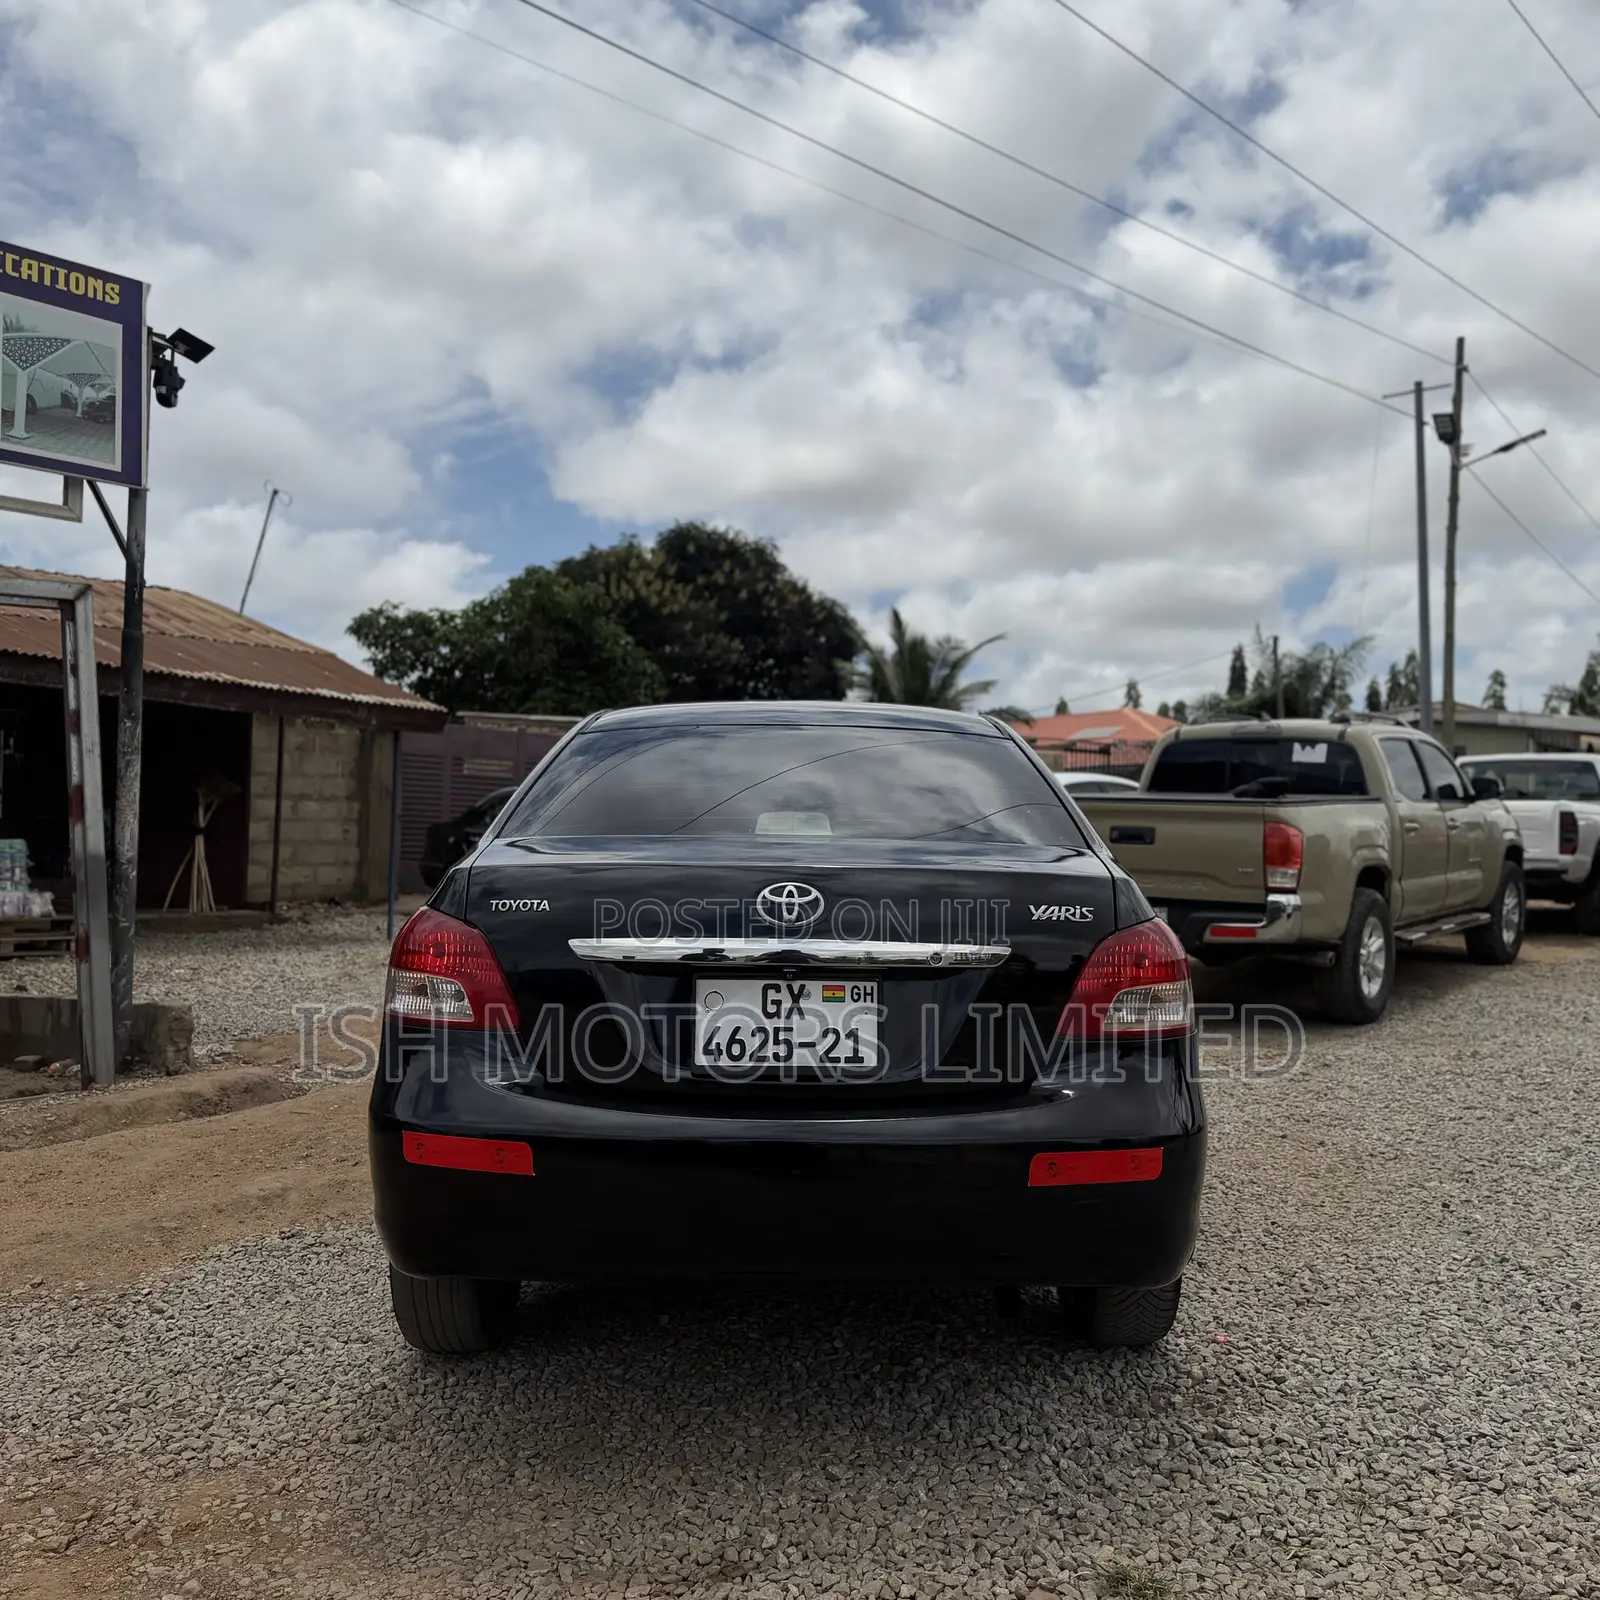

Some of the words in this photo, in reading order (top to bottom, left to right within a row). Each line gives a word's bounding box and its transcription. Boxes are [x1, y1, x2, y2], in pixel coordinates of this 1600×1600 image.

[0, 251, 120, 305] CATIONS
[490, 899, 550, 912] TOYOTA
[761, 983, 806, 1020] GX
[850, 985, 874, 1003] GH
[702, 1025, 865, 1064] 4625-21
